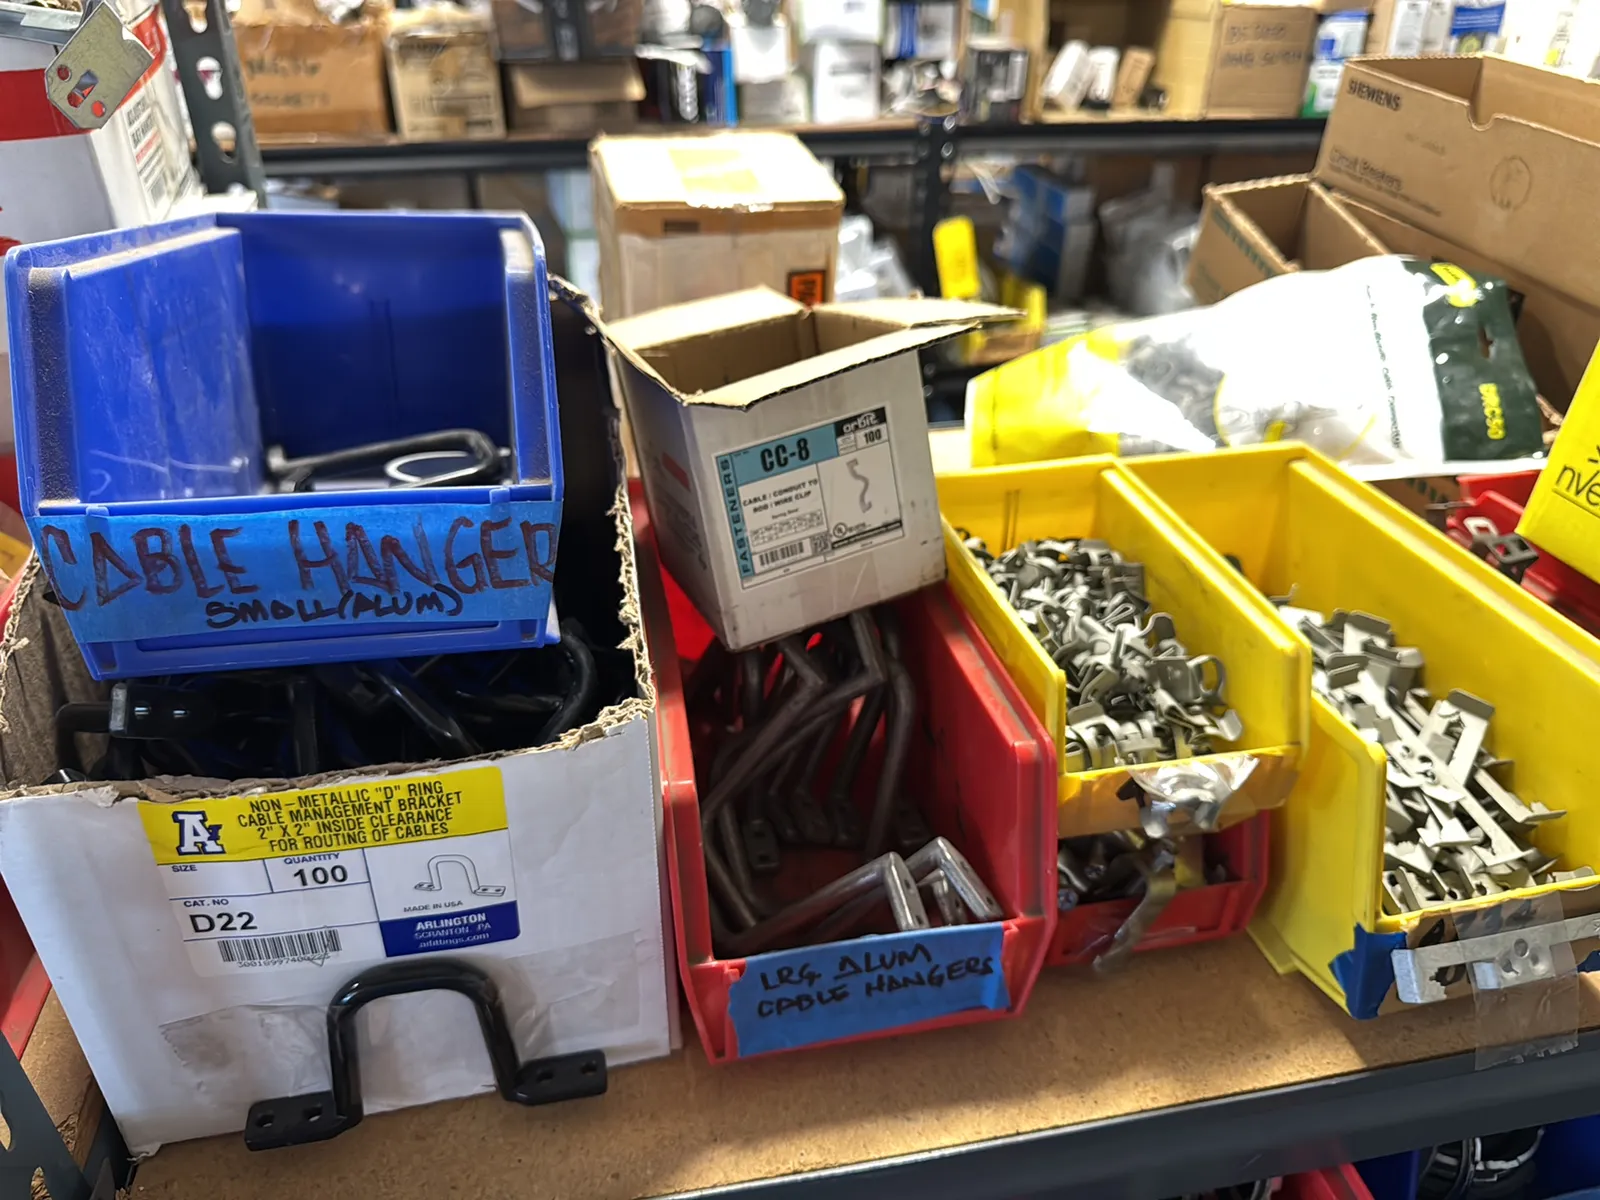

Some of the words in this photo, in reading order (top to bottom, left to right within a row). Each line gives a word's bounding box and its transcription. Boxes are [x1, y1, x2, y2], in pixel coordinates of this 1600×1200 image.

[1347, 78, 1401, 111] SIEMENS
[842, 411, 880, 433] orbit
[863, 428, 883, 445] 100
[760, 437, 810, 473] CC-8
[743, 494, 767, 507] CABLE
[773, 482, 806, 498] CONDUIT
[719, 458, 750, 574] FASTENERS
[40, 523, 261, 611] CABLE
[288, 515, 557, 595] HANGER
[250, 799, 282, 813] NON
[297, 788, 371, 810] METALLIC
[407, 780, 444, 797] RING
[237, 813, 285, 828] CABLE
[289, 799, 393, 823] MANAGEMENT
[397, 791, 463, 813] BRACKET
[257, 825, 274, 840] 2"
[281, 824, 292, 838] X
[296, 822, 311, 836] 2"
[316, 817, 366, 834] INSIDE
[369, 807, 454, 828] CLEARANCE
[269, 837, 299, 852] FOR
[303, 829, 368, 849] ROUTING
[371, 828, 391, 843] OF
[395, 822, 450, 840] CABLES
[171, 864, 198, 873] SIZE
[283, 852, 341, 865] QUANTITY
[293, 864, 349, 888] 100
[183, 899, 211, 908] CAT.
[212, 898, 230, 906] NO
[403, 905, 431, 914] MADE
[432, 903, 442, 911] IN
[444, 900, 464, 909] USA
[188, 911, 258, 934] D22
[415, 912, 487, 932] ARLINGTON
[476, 922, 492, 933] PA
[760, 963, 823, 991] LRG
[833, 942, 933, 980] ALUM
[757, 984, 851, 1018] CABLE
[865, 955, 995, 998] HANGERS
